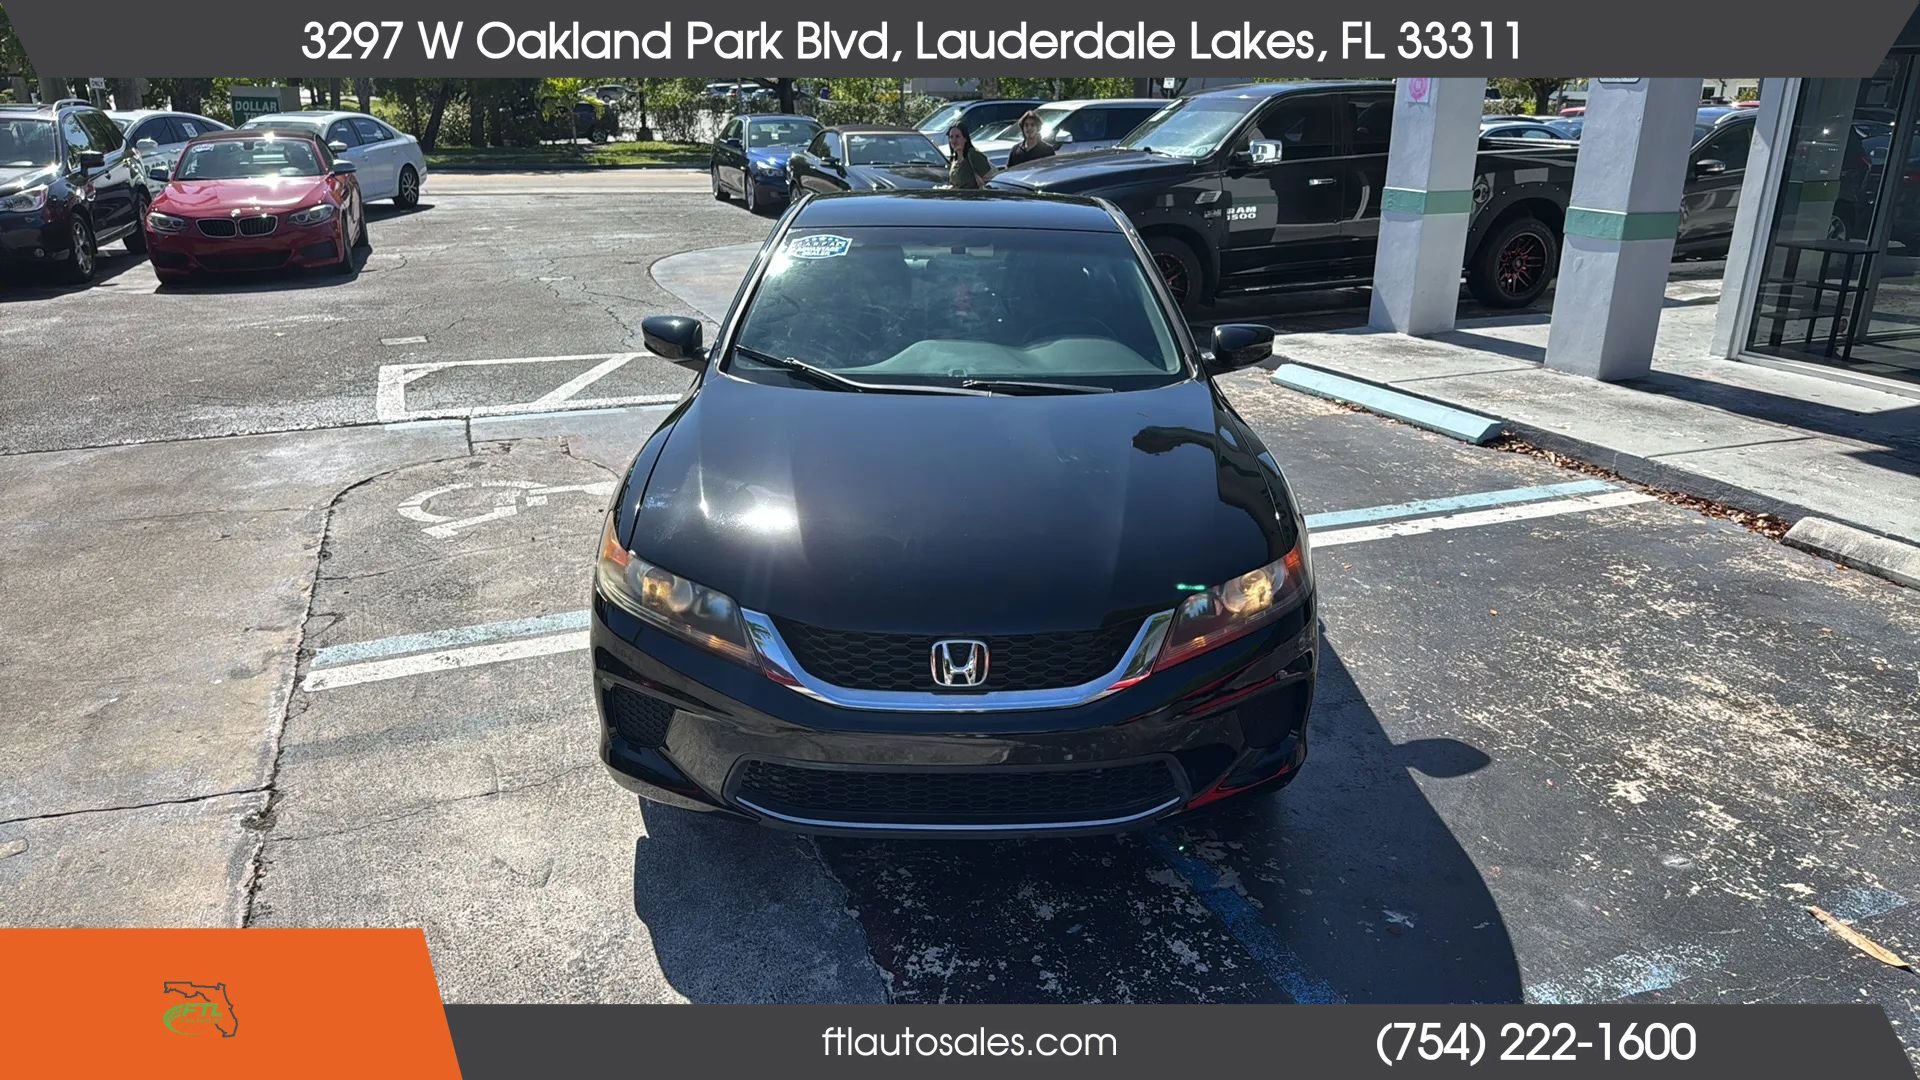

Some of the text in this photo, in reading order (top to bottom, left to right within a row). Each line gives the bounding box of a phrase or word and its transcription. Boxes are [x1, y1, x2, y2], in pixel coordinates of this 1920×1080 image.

[235, 101, 277, 112] DOLLAR
[1226, 205, 1257, 214] RAM
[1226, 213, 1256, 221] 1500
